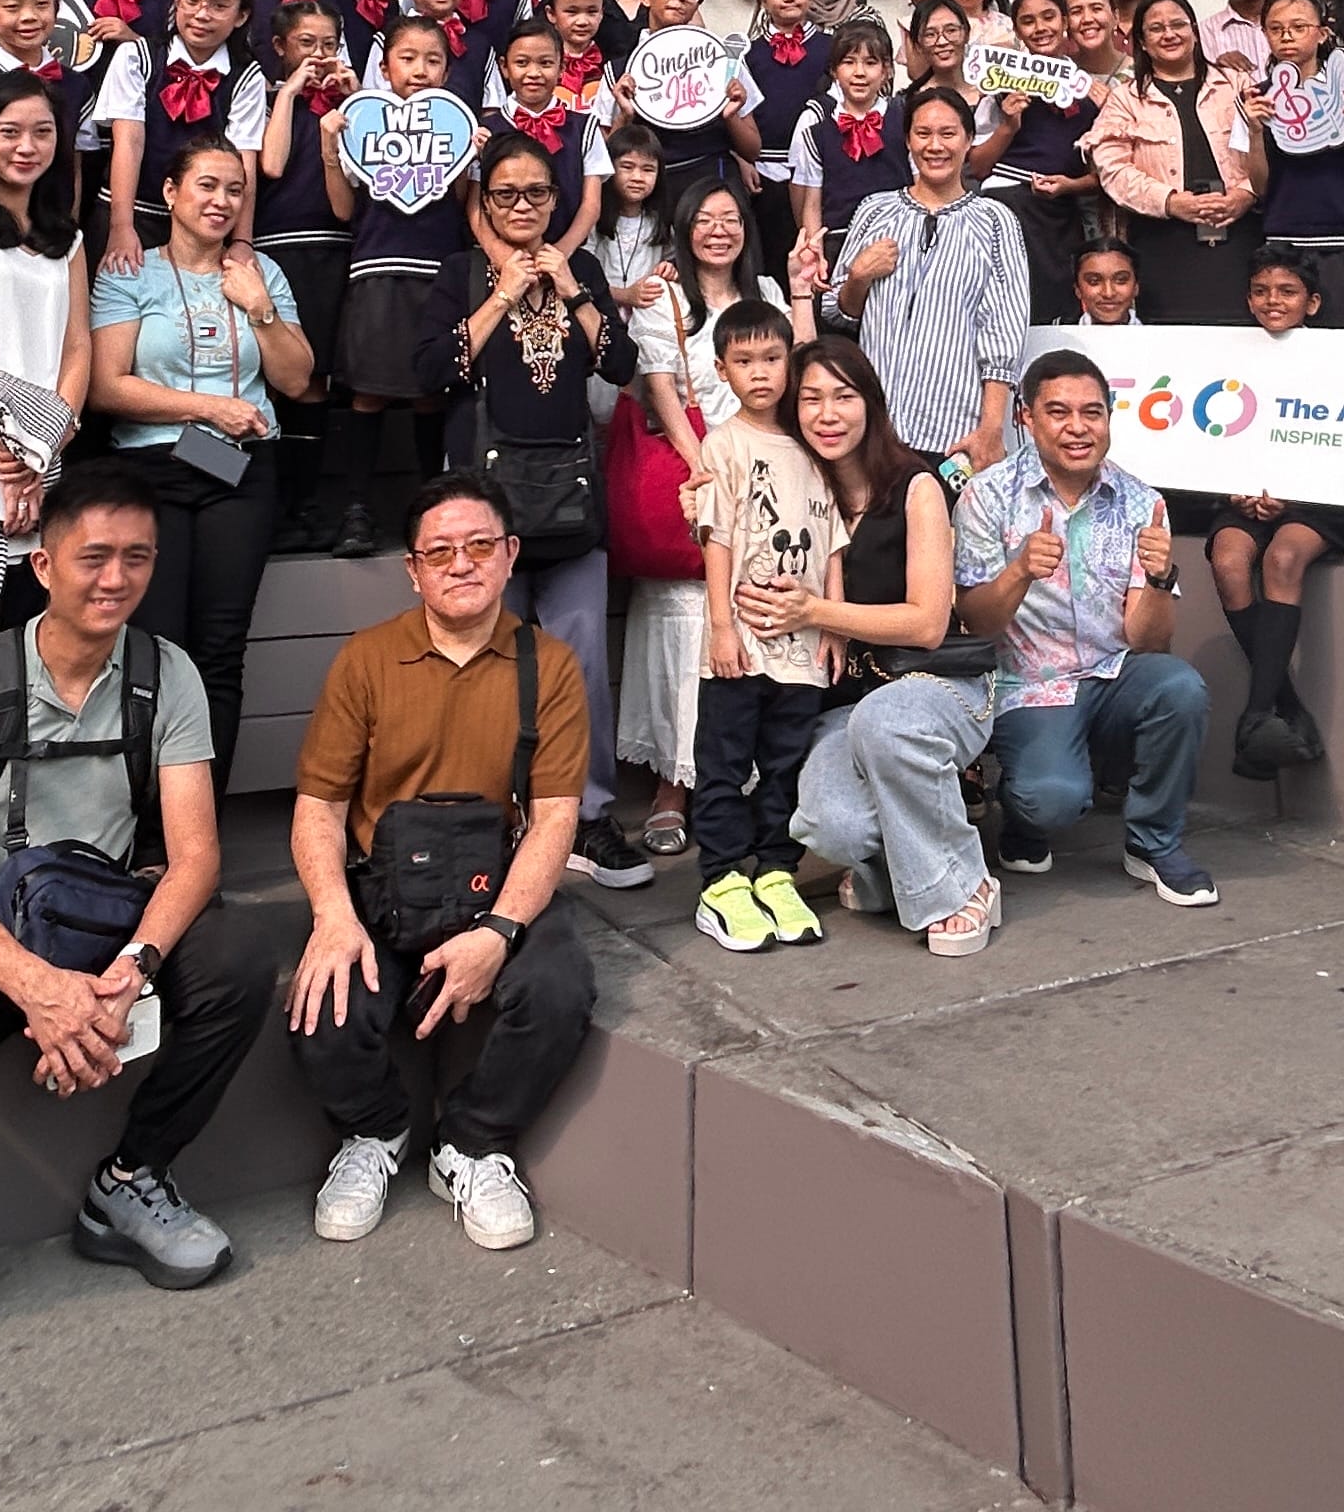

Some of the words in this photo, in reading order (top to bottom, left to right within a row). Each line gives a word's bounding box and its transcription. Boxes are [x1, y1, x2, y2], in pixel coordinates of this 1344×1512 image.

[638, 42, 723, 91] Singing
[984, 49, 1018, 68] WE
[1021, 57, 1072, 80] LOVE
[665, 73, 715, 119] Life!
[980, 65, 1059, 99] Singing
[382, 100, 434, 133] WE
[361, 131, 455, 166] LOVE
[374, 166, 444, 193] SYF!
[1275, 397, 1329, 422] The
[1269, 428, 1343, 448] INSPIRE
